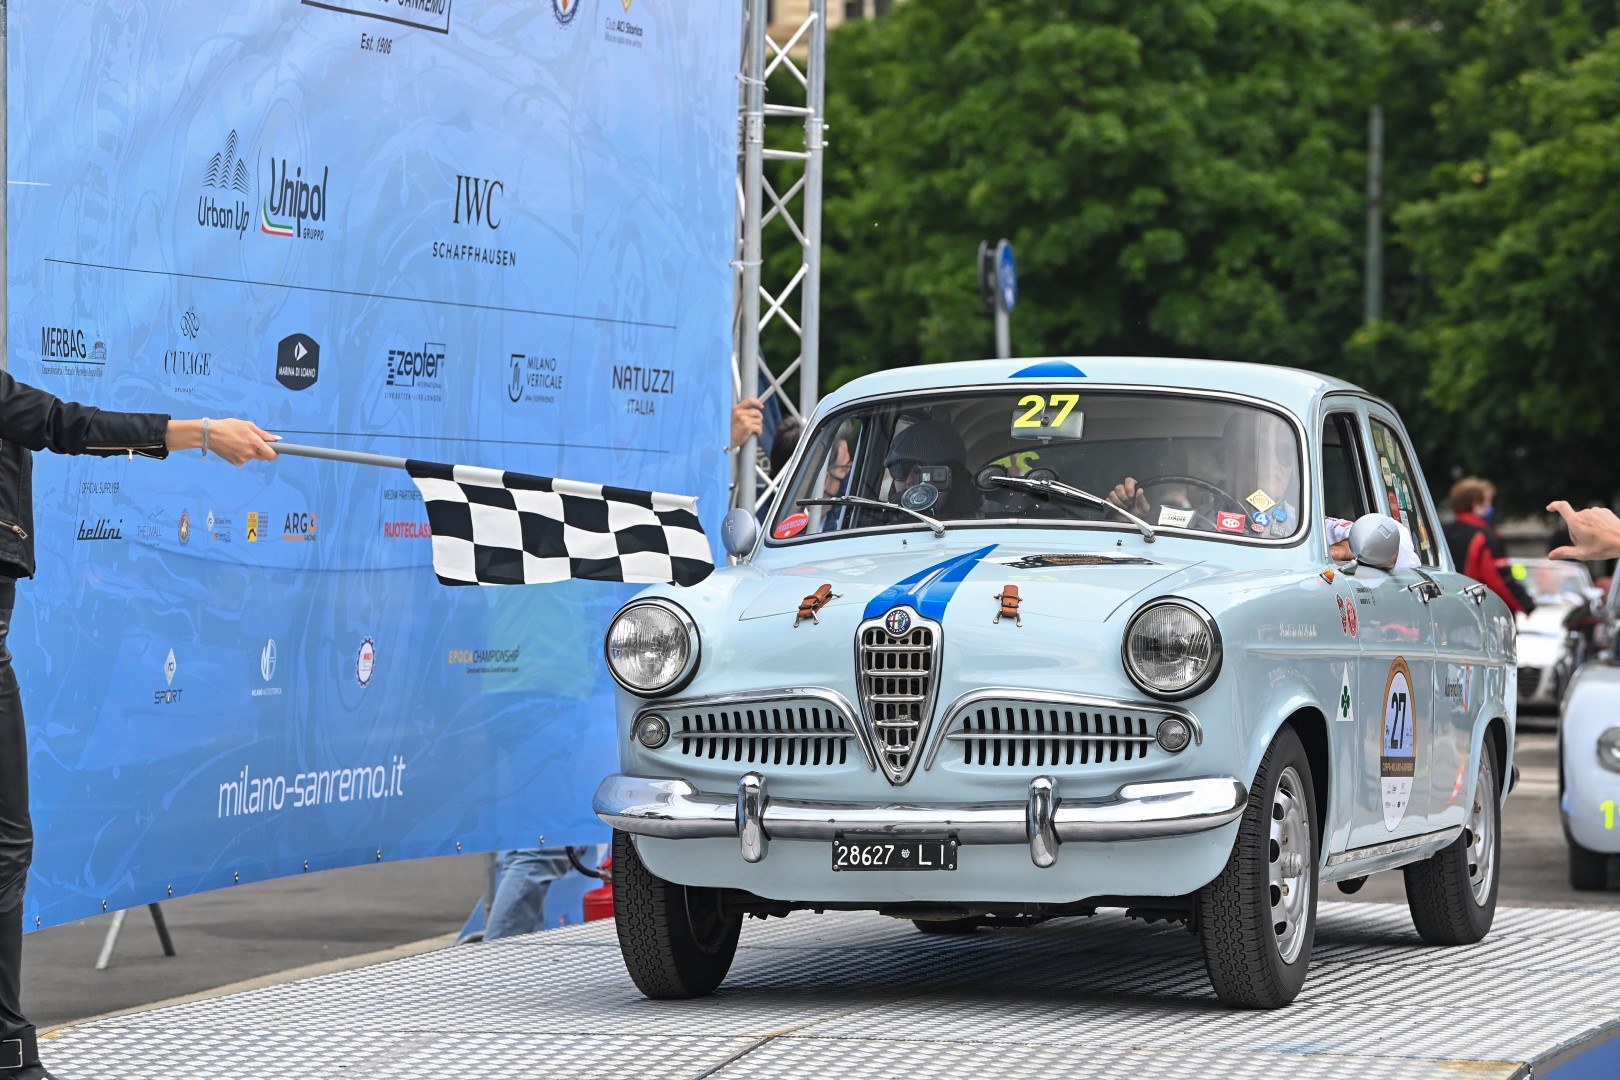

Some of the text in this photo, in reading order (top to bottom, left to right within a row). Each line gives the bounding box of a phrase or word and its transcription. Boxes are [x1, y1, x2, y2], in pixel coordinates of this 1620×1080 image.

[360, 33, 393, 55] Est. 1906
[269, 157, 329, 238] Unipol
[453, 174, 504, 230] IWC
[198, 196, 250, 240] Urban Up
[303, 228, 325, 241] GRUPPO
[432, 241, 516, 267] SCHAFFHAUSEN
[41, 326, 87, 359] MERBAG
[164, 349, 212, 376] CUVAGE
[278, 366, 316, 378] MARINA DI LOANO
[396, 342, 446, 388] zepter
[527, 357, 557, 371] MILANO
[526, 373, 563, 390] VERTICALE
[612, 365, 675, 394] NATUZZI
[627, 399, 655, 415] ITALIA
[1013, 394, 1080, 429] 27
[81, 482, 98, 494] OFFICIAL
[384, 489, 398, 500] MEDIA
[77, 518, 123, 540] bellini
[1254, 511, 1268, 526] 4
[154, 689, 183, 704] SPORT
[1390, 692, 1407, 749] 27
[218, 755, 406, 818] milano-sanremo.it
[837, 845, 895, 866] 28627
